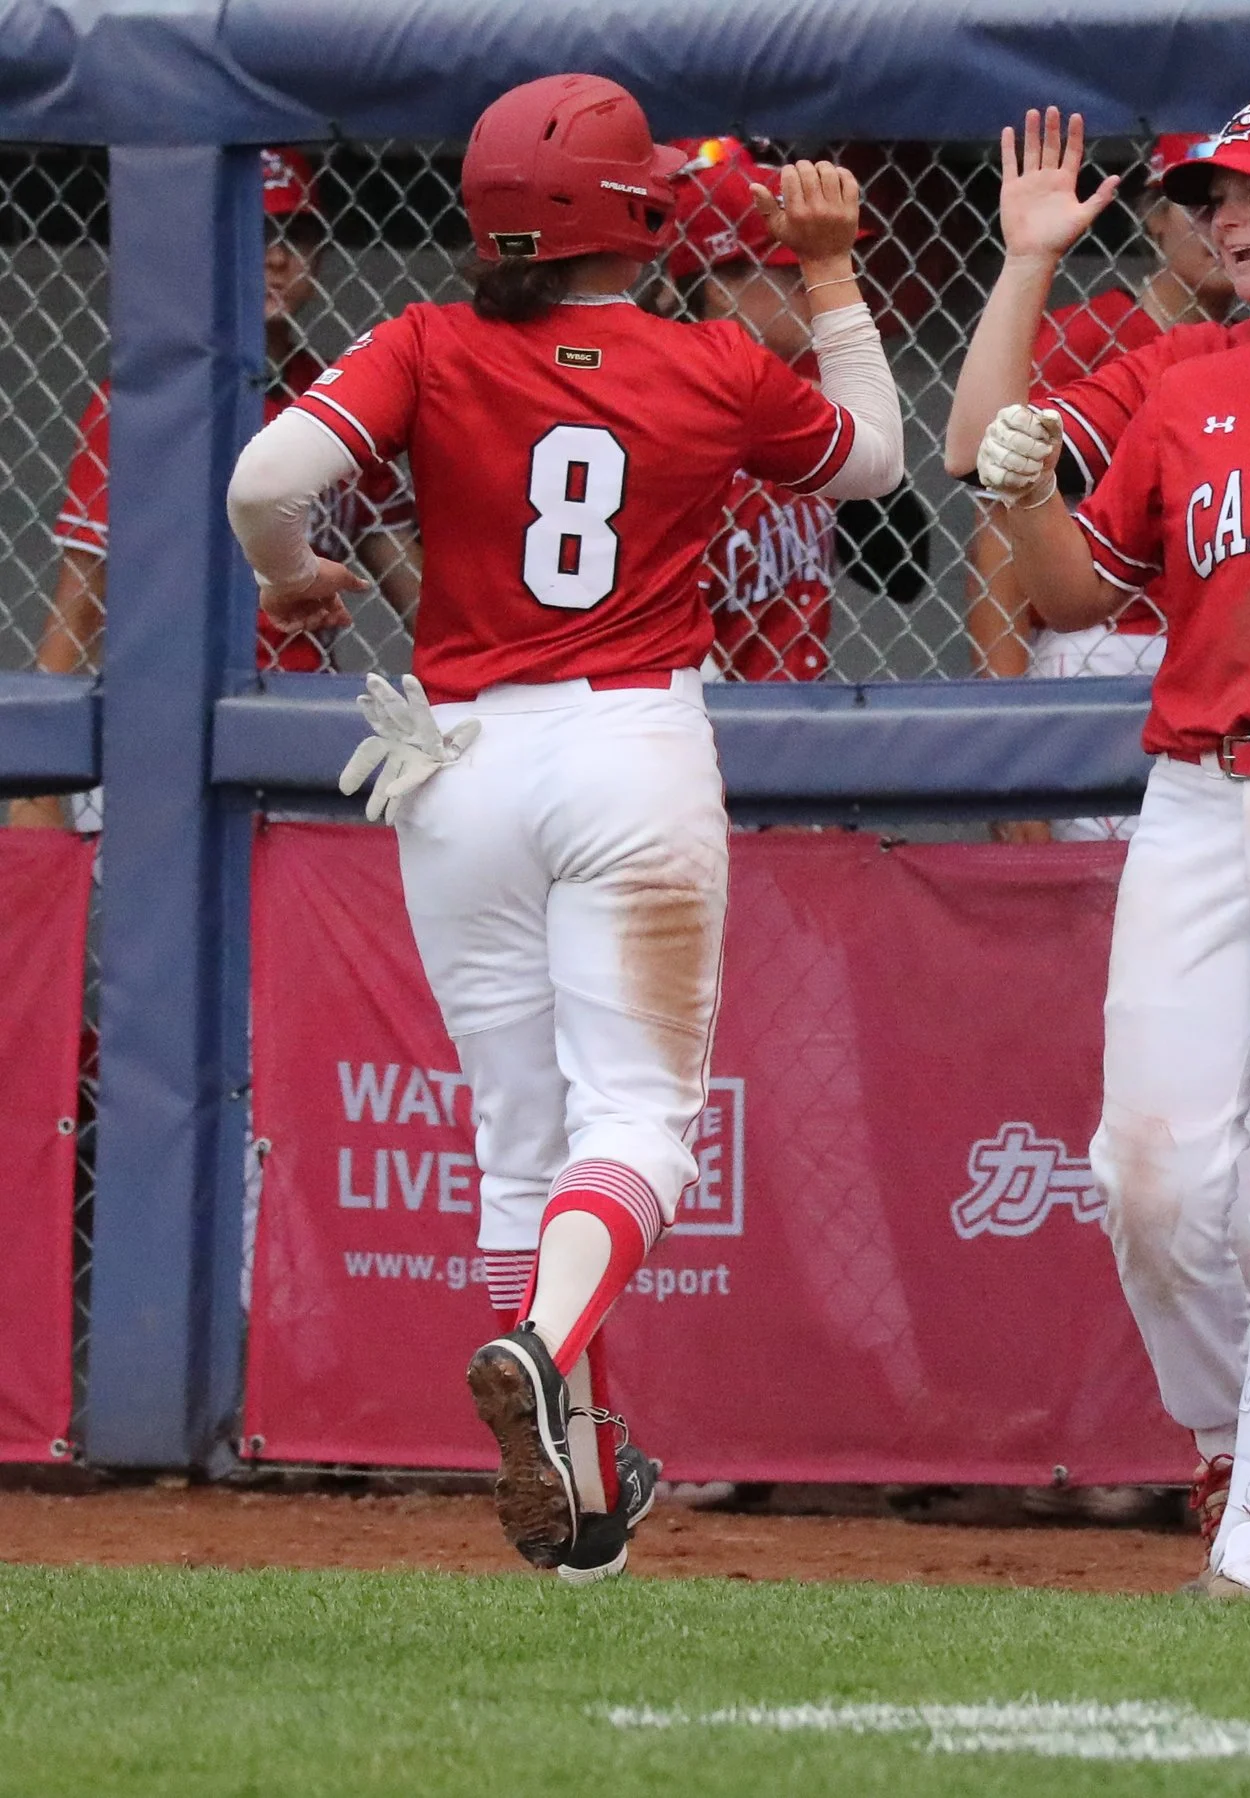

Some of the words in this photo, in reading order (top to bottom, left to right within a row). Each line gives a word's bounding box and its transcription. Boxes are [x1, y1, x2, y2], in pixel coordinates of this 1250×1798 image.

[600, 180, 648, 196] RAWLINGS
[565, 352, 592, 361] WBSC
[521, 421, 629, 612] 8
[337, 1060, 474, 1127] WAT
[338, 1147, 476, 1214] LIVE
